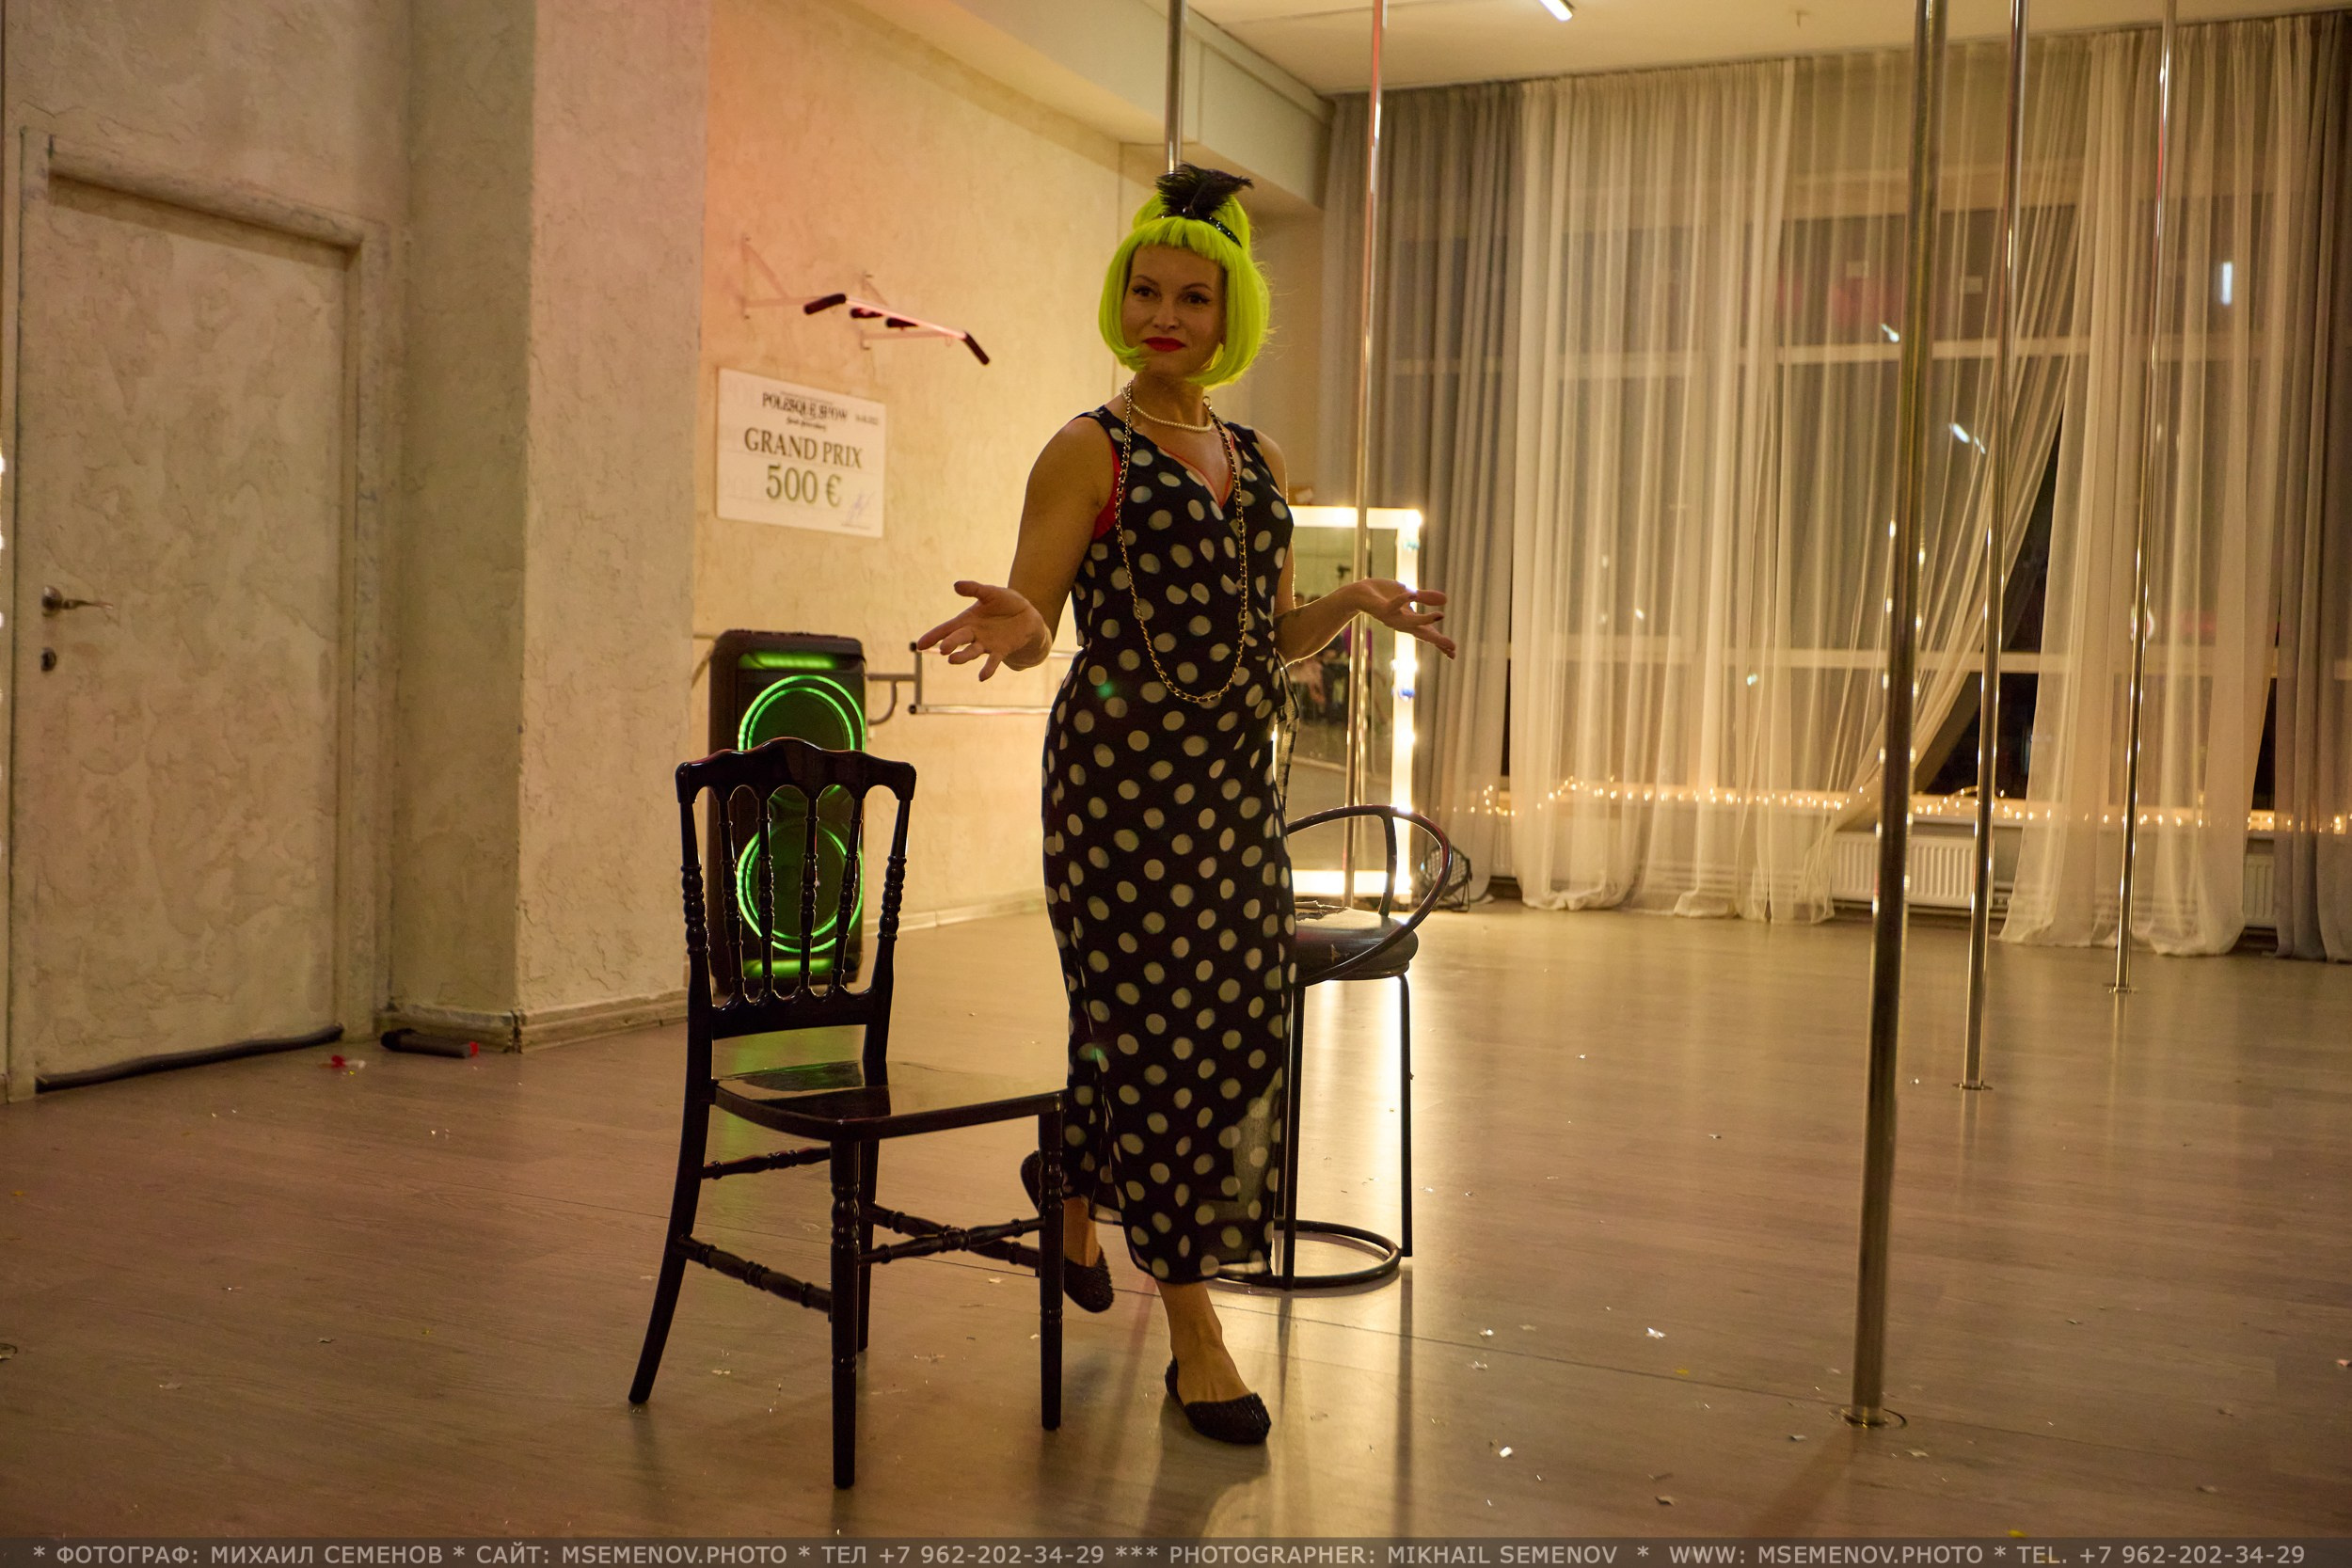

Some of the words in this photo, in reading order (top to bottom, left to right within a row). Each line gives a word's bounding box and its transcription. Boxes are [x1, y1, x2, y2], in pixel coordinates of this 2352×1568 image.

[818, 404, 848, 420] SHOW
[745, 428, 818, 460] GRAND
[823, 442, 863, 469] PRIX
[767, 464, 817, 503] 500
[826, 474, 842, 508] €
